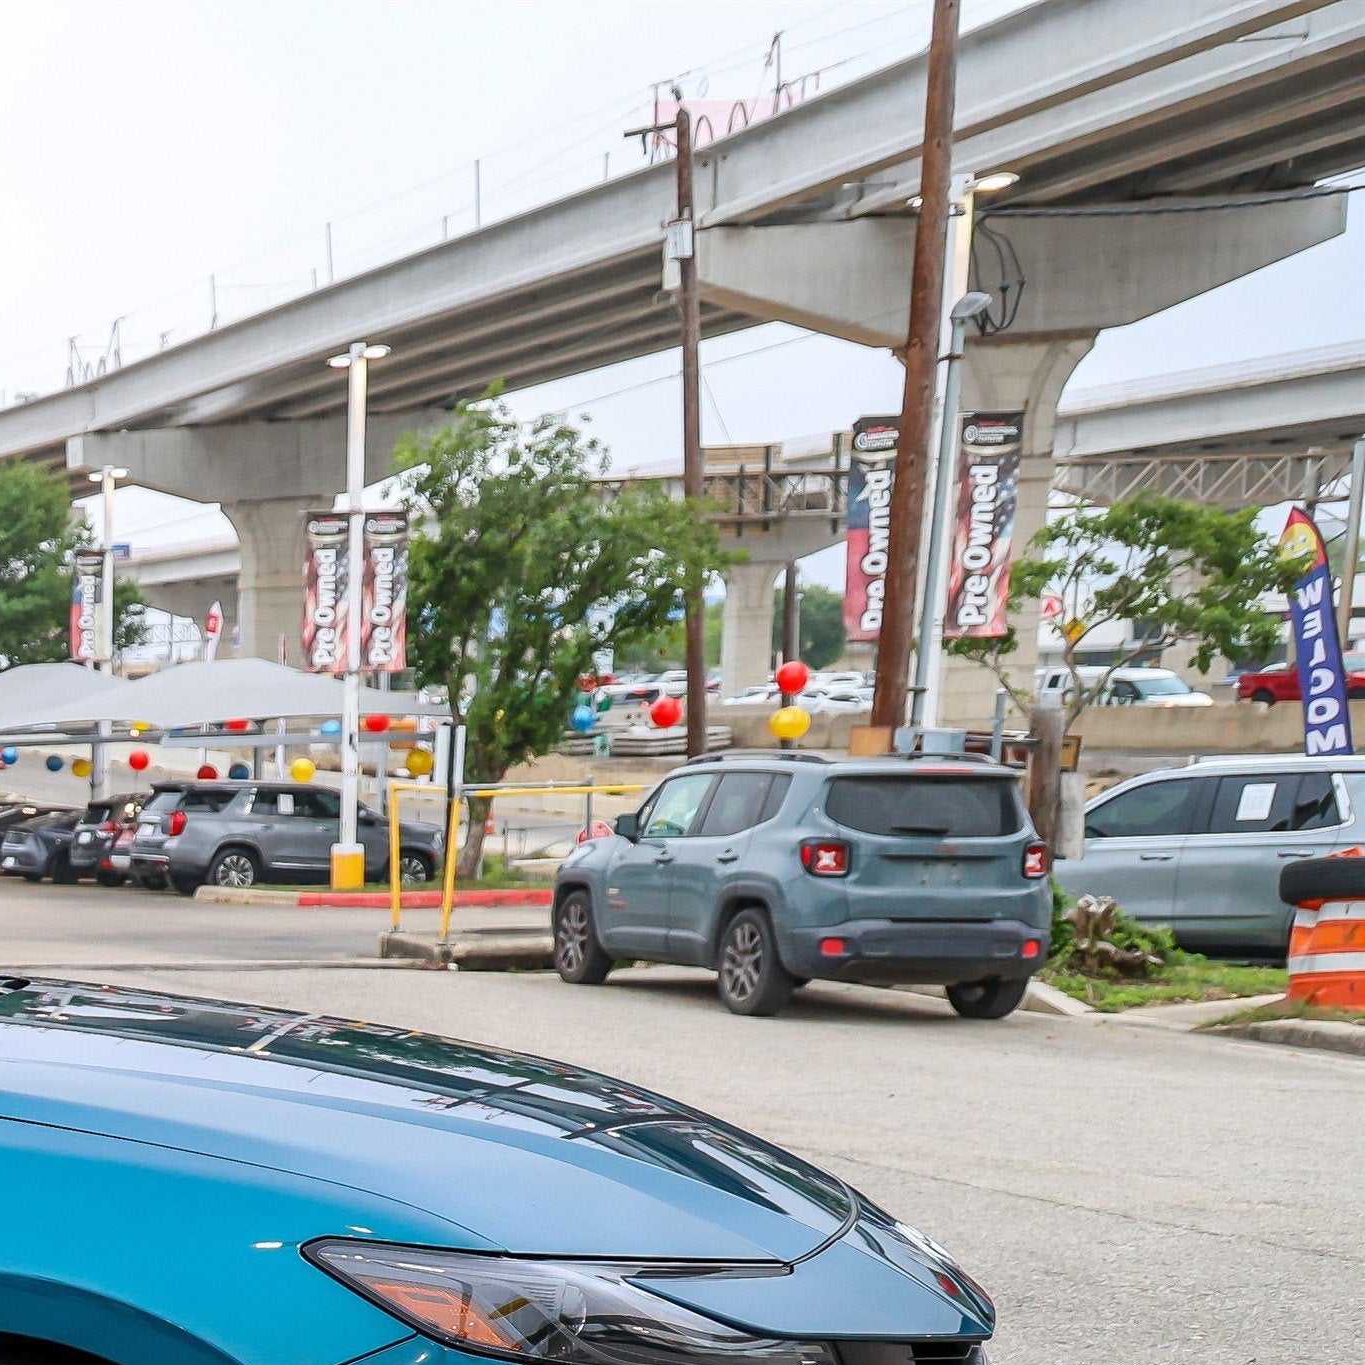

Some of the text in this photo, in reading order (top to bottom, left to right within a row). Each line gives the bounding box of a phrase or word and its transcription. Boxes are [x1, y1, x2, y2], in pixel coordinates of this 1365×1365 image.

[860, 470, 892, 576] Owned
[962, 465, 999, 571] Owned
[314, 548, 337, 626] Owned
[370, 548, 394, 626] Owned
[957, 573, 989, 626] Pre
[312, 627, 336, 665] Pre
[369, 626, 392, 664] Pre
